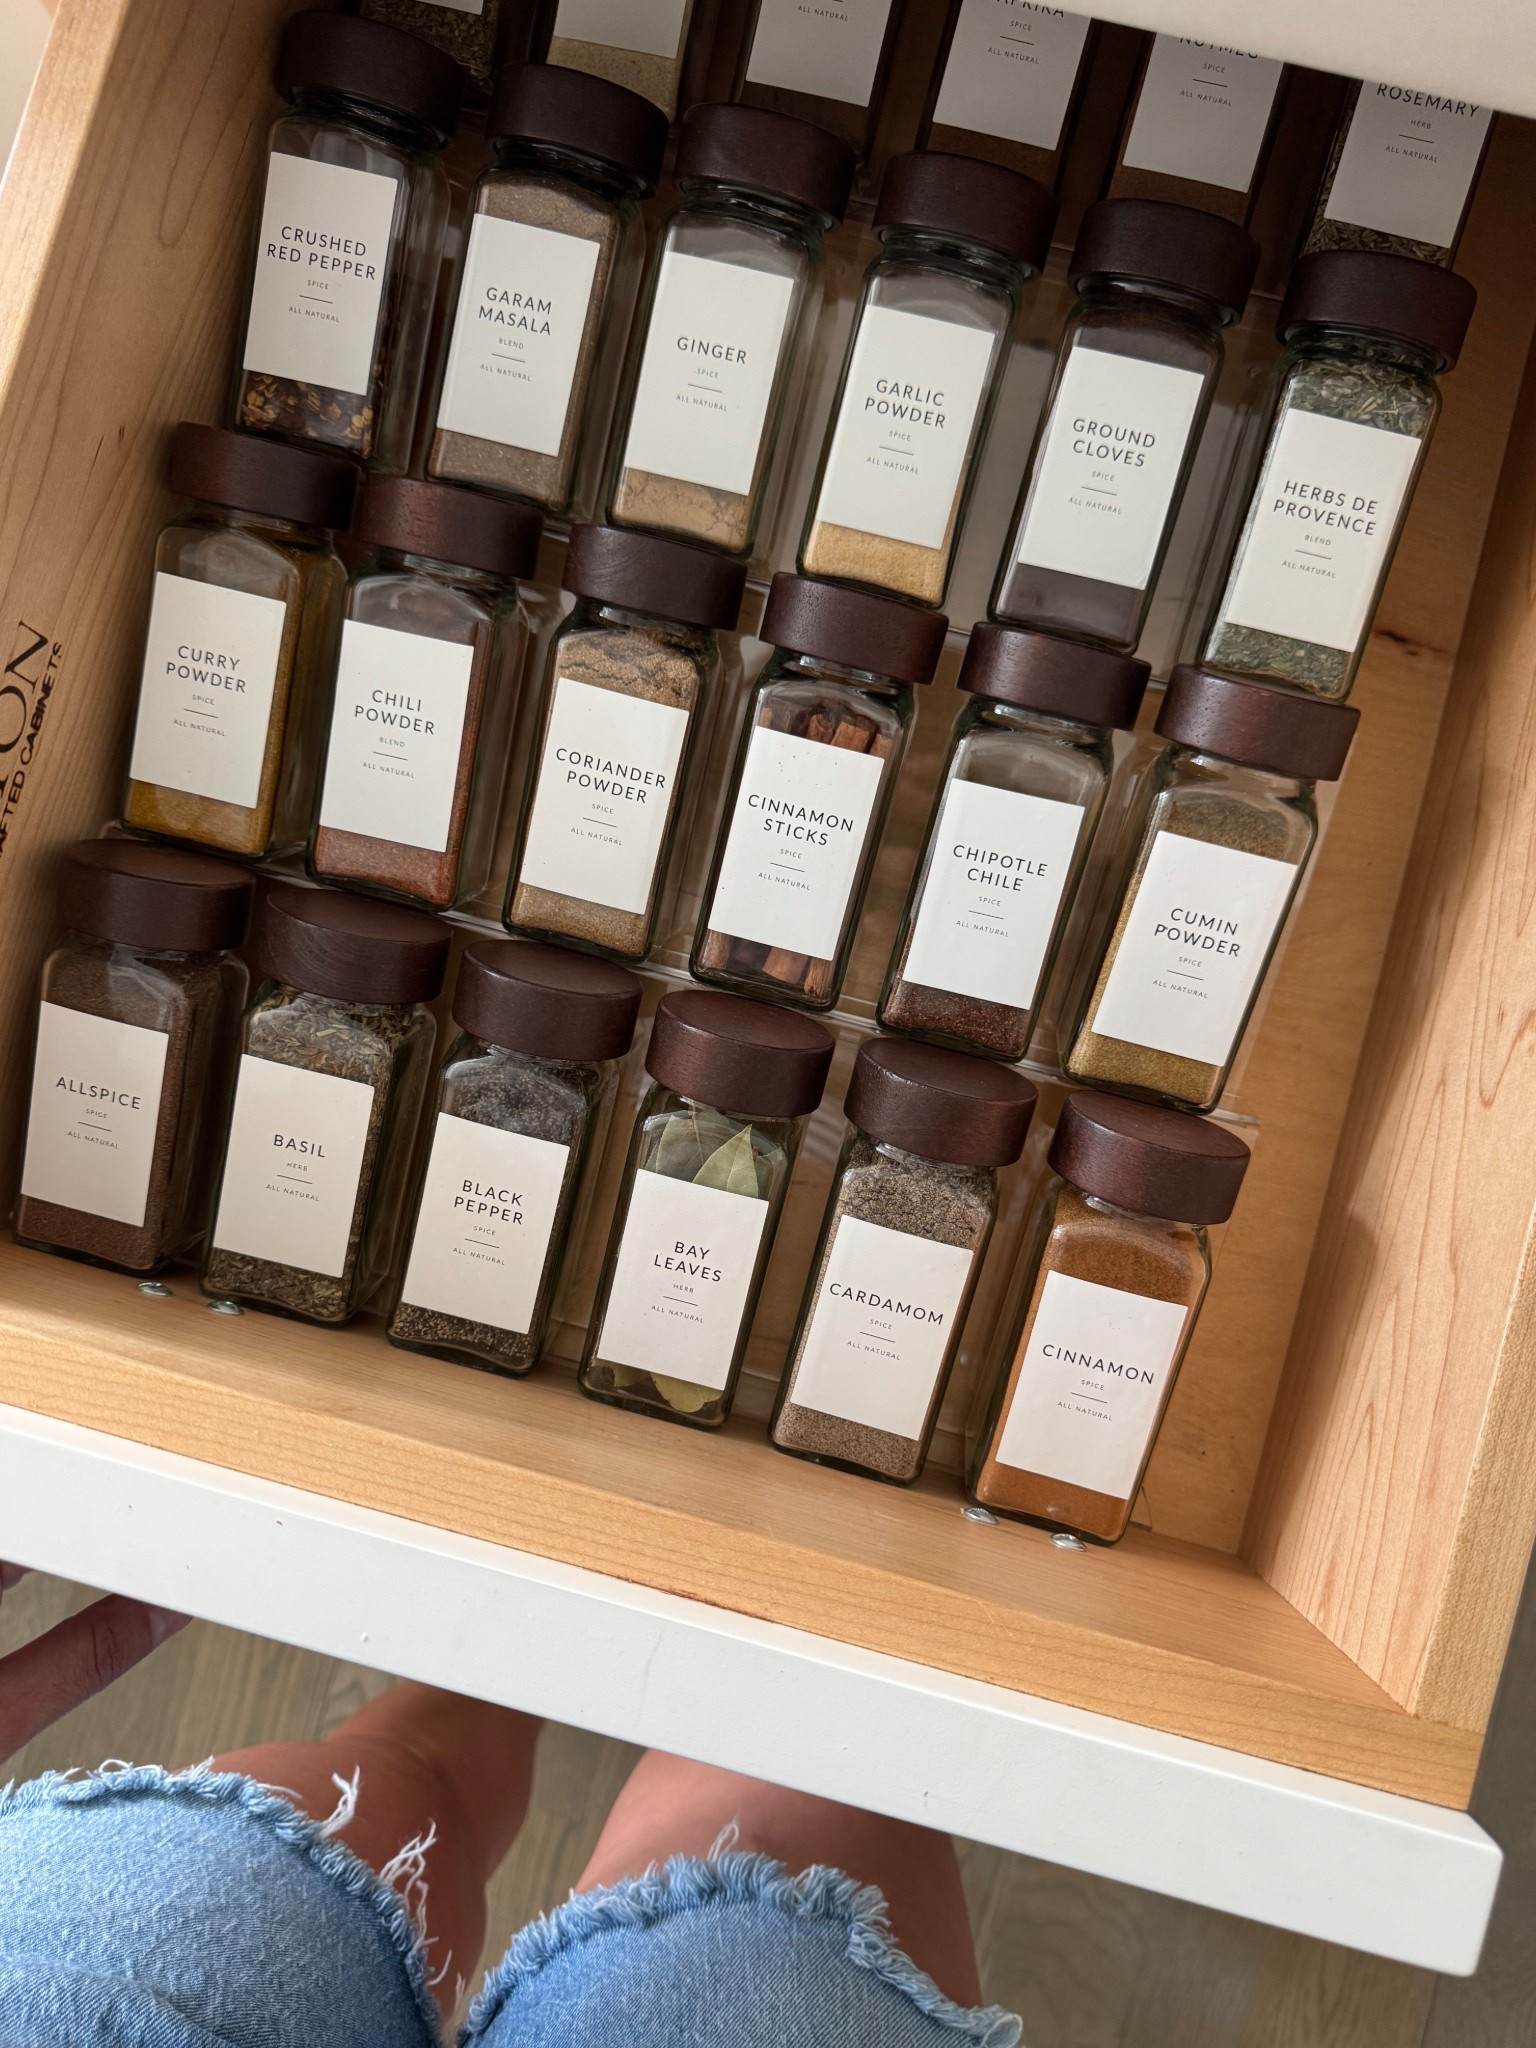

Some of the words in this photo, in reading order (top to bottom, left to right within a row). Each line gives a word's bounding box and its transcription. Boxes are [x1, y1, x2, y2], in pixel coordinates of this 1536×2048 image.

[797, 5, 810, 14] ALL
[814, 8, 848, 22] NATURAL
[1009, 20, 1032, 32] SPICE
[987, 47, 1001, 56] ALL
[1004, 51, 1038, 65] NATURAL
[1203, 63, 1225, 74] SPICE
[1180, 90, 1193, 98] ALL
[1197, 93, 1232, 107] NATURAL
[1376, 83, 1479, 118] ROSEMARY
[1410, 119, 1432, 130] HERB
[1385, 145, 1399, 154] ALL
[1402, 149, 1438, 163] NATURAL
[281, 226, 366, 256] CRUSHED
[267, 243, 301, 263] RED
[308, 252, 376, 280] PEPPER
[307, 279, 329, 290] SPICE
[486, 287, 552, 315] GARAM
[288, 306, 302, 315] ALL
[305, 309, 339, 323] NATURAL
[478, 305, 551, 336] MASALA
[498, 337, 524, 349] BLEND
[677, 336, 747, 365] GINGER
[480, 363, 493, 373] ALL
[497, 367, 530, 382] NATURAL
[697, 367, 719, 379] SPICE
[876, 379, 944, 407] GARLIC
[676, 394, 689, 403] ALL
[693, 397, 727, 412] NATURAL
[864, 397, 946, 429] POWDER
[888, 430, 911, 442] SPICE
[1073, 418, 1156, 448] GROUND
[1073, 439, 1145, 467] CLOVES
[866, 456, 880, 466] ALL
[883, 460, 918, 475] NATURAL
[1091, 470, 1115, 482] SPICE
[1068, 497, 1082, 506] ALL
[1085, 500, 1121, 515] NATURAL
[1283, 480, 1346, 507] HERBS
[1351, 496, 1378, 515] DE
[1273, 499, 1376, 536] PROVENCE
[1304, 534, 1332, 546] BLEND
[1281, 560, 1296, 569] ALL
[1299, 564, 1335, 579] NATURAL
[177, 645, 240, 671] CURRY
[166, 661, 246, 694] POWDER
[20, 642, 62, 766] CABINETS
[192, 694, 214, 706] SPICE
[372, 689, 422, 713] CHILI
[173, 719, 188, 728] ALL
[190, 723, 225, 737] NATURAL
[354, 704, 435, 735] POWDER
[379, 736, 406, 748] BLEND
[362, 762, 376, 770] ALL
[379, 765, 415, 779] NATURAL
[556, 748, 666, 789] CORIANDER
[566, 770, 647, 804] POWDER
[591, 803, 614, 815] SPICE
[748, 794, 854, 833] CINNAMON
[570, 827, 584, 836] ALL
[587, 831, 622, 846] NATURAL
[763, 818, 828, 846] STICKS
[780, 848, 802, 860] SPICE
[953, 844, 1048, 877] CHIPOTLE
[758, 872, 771, 881] ALL
[775, 876, 810, 891] NATURAL
[967, 868, 1024, 892] CHILE
[978, 896, 1001, 907] SPICE
[956, 920, 969, 928] ALL
[973, 924, 1009, 938] NATURAL
[1170, 908, 1239, 936] CUMIN
[1154, 923, 1240, 957] POWDER
[1177, 956, 1203, 968] SPICE
[1152, 979, 1167, 988] ALL
[1170, 984, 1207, 999] NATURAL
[55, 1076, 141, 1110] ALLSPICE
[85, 1108, 108, 1119] SPICE
[67, 1131, 81, 1139] ALL
[84, 1135, 118, 1150] NATURAL
[273, 1134, 326, 1158] BASIL
[286, 1162, 308, 1172] HERB
[266, 1184, 280, 1192] ALL
[283, 1188, 319, 1202] NATURAL
[462, 1179, 523, 1206] BLACK
[453, 1196, 523, 1225] PEPPER
[473, 1225, 496, 1236] SPICE
[452, 1247, 466, 1256] ALL
[470, 1251, 505, 1266] NATURAL
[674, 1241, 710, 1260] BAY
[654, 1254, 722, 1282] LEAVES
[673, 1284, 694, 1294] HERB
[829, 1283, 944, 1326] CARDAMOM
[651, 1305, 665, 1313] ALL
[668, 1309, 704, 1324] NATURAL
[870, 1319, 893, 1330] SPICE
[847, 1340, 860, 1349] ALL
[864, 1345, 900, 1361] NATURAL
[1042, 1344, 1154, 1385] CINNAMON
[1080, 1379, 1105, 1391] SPICE
[1057, 1401, 1072, 1410] ALL
[1075, 1406, 1113, 1422] NATURAL
